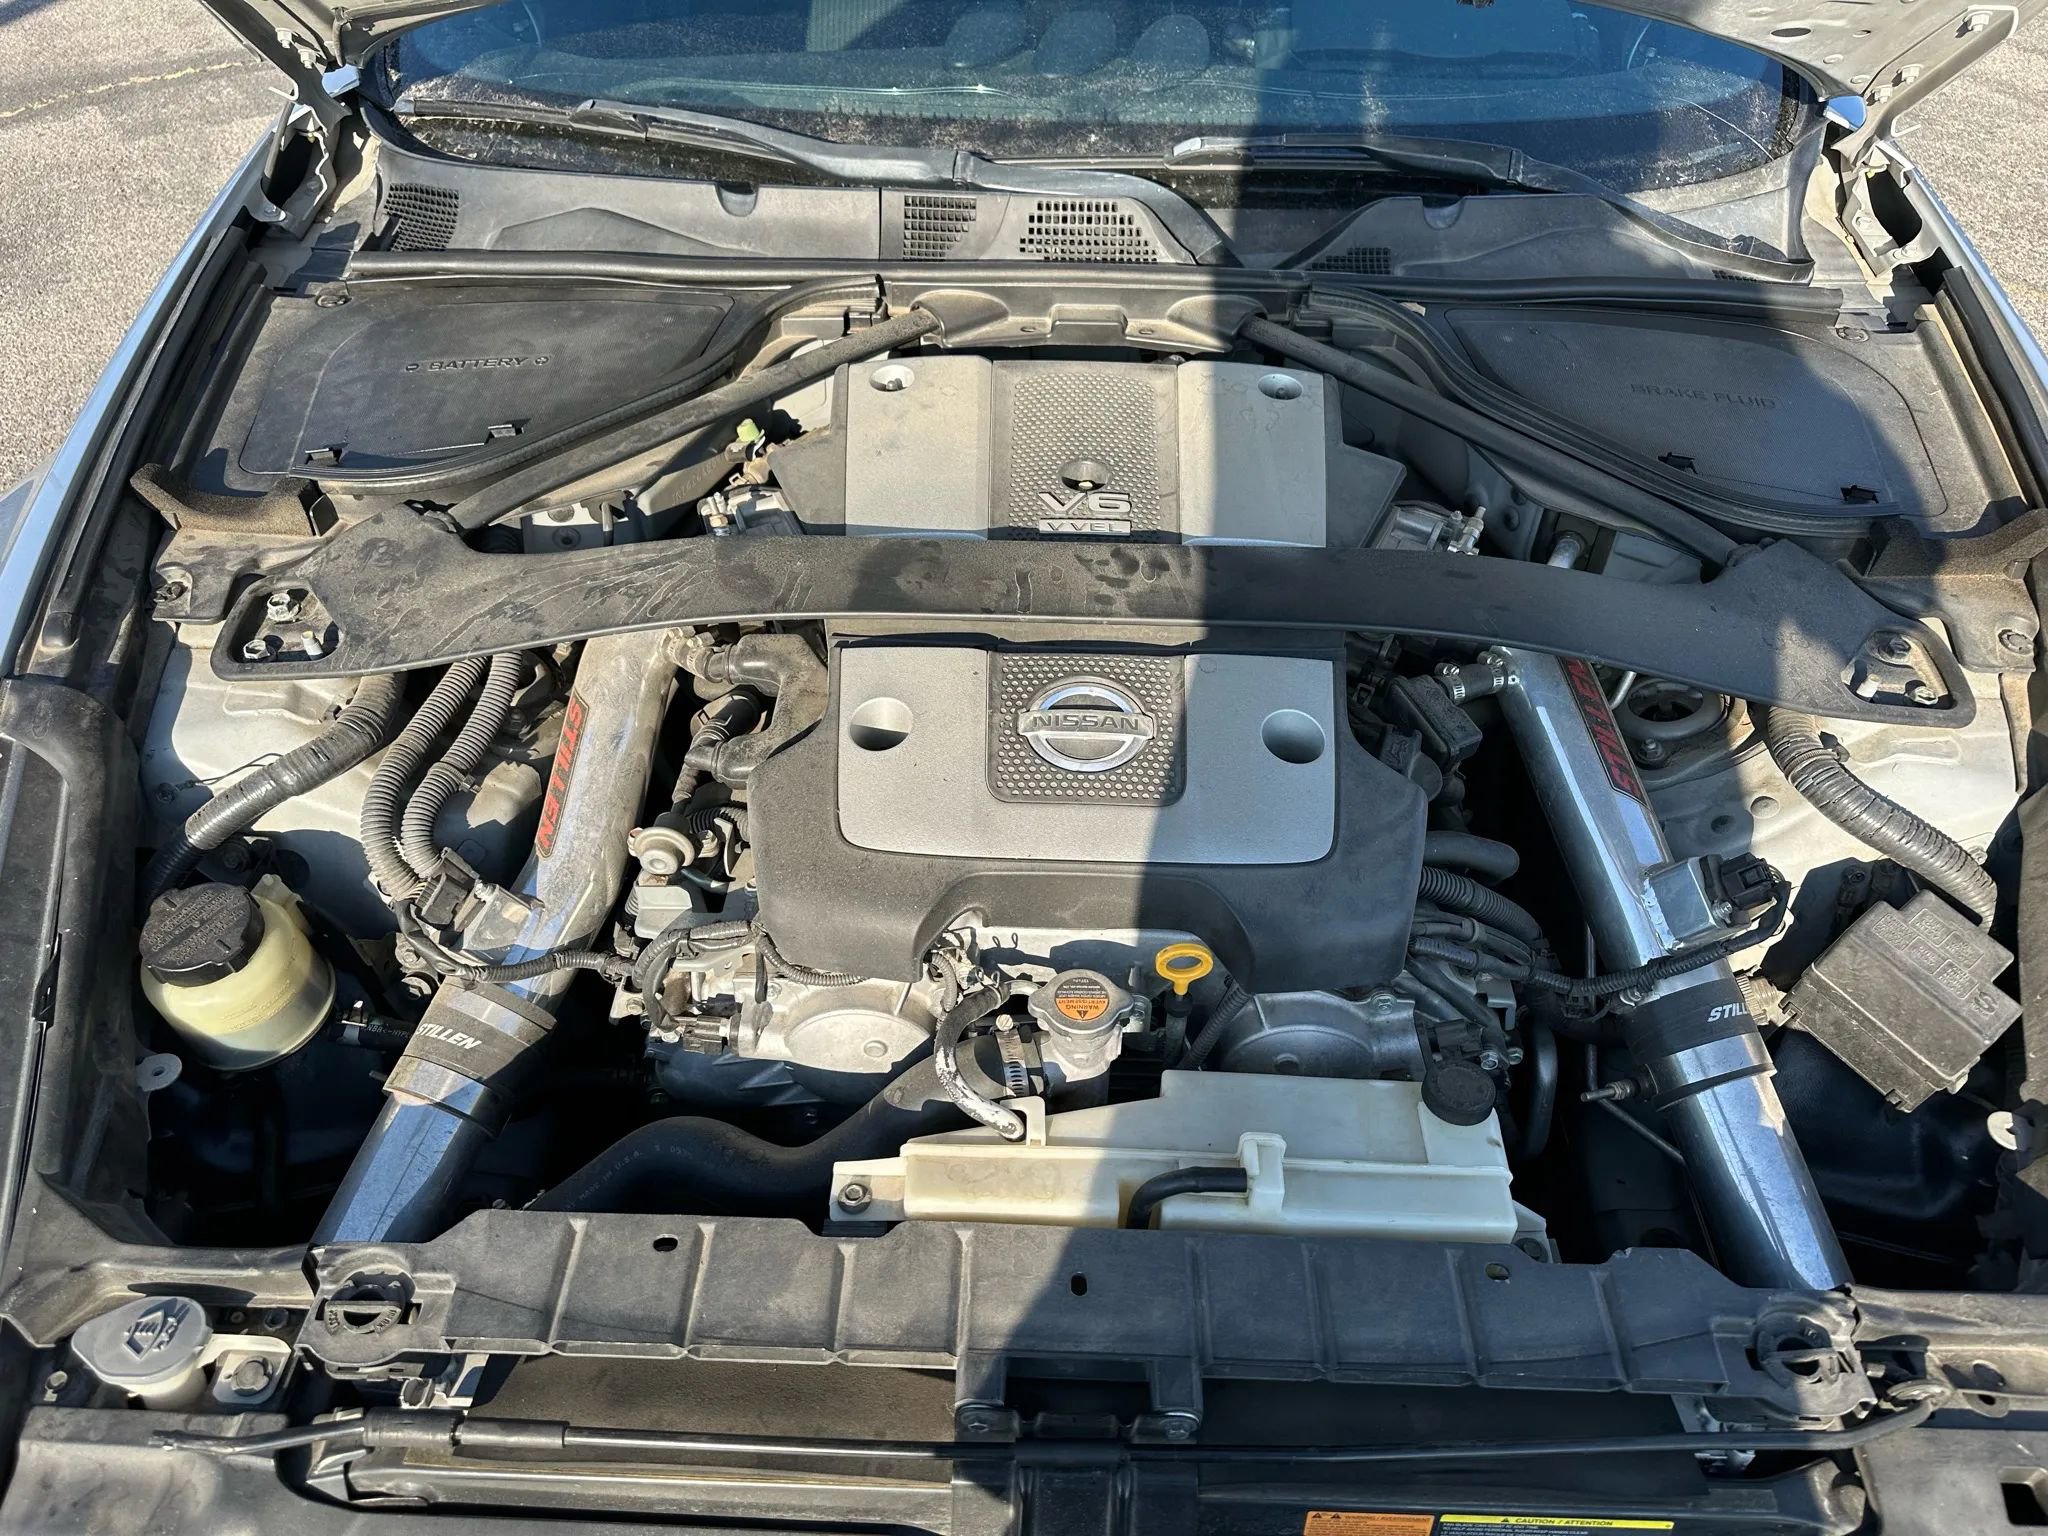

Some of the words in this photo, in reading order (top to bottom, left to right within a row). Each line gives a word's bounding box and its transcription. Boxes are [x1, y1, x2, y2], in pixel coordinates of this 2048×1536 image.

[428, 356, 529, 371] BATTERY
[1630, 383, 1706, 401] BRAKE
[1713, 392, 1777, 409] FLUID
[1039, 491, 1132, 516] V6
[1047, 521, 1123, 533] VVEL
[1032, 713, 1140, 732] NISSAN
[538, 696, 583, 849] STILLEN
[1707, 1002, 1749, 1022] STILL
[415, 1022, 482, 1050] STILLEN
